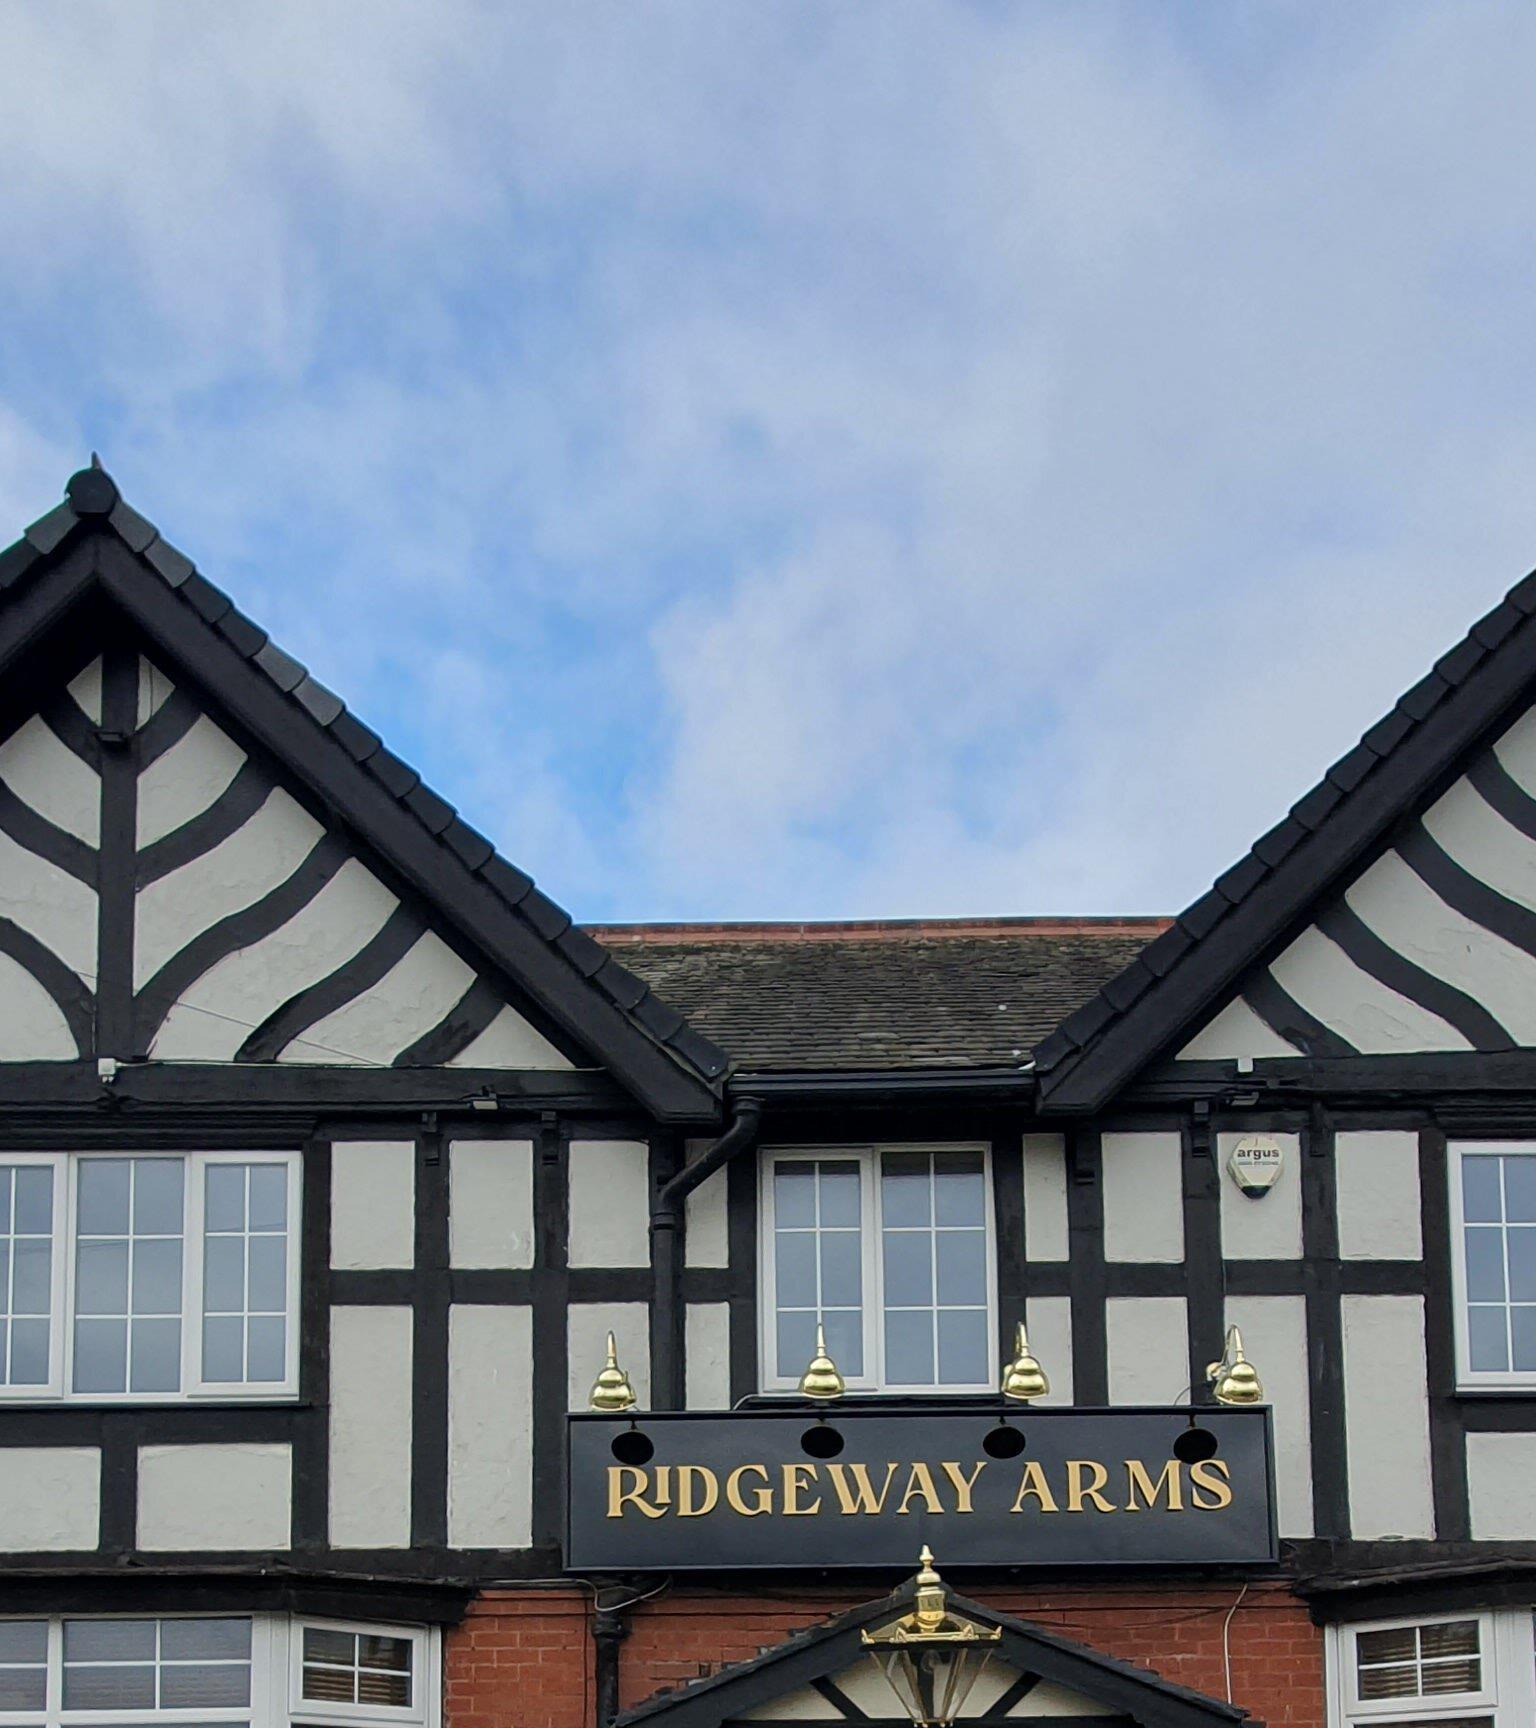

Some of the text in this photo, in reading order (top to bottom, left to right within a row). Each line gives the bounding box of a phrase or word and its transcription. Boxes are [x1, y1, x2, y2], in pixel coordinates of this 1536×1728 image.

[1237, 1148, 1280, 1160] argus
[605, 1459, 1234, 1519] RIDGEWAY ARMS
